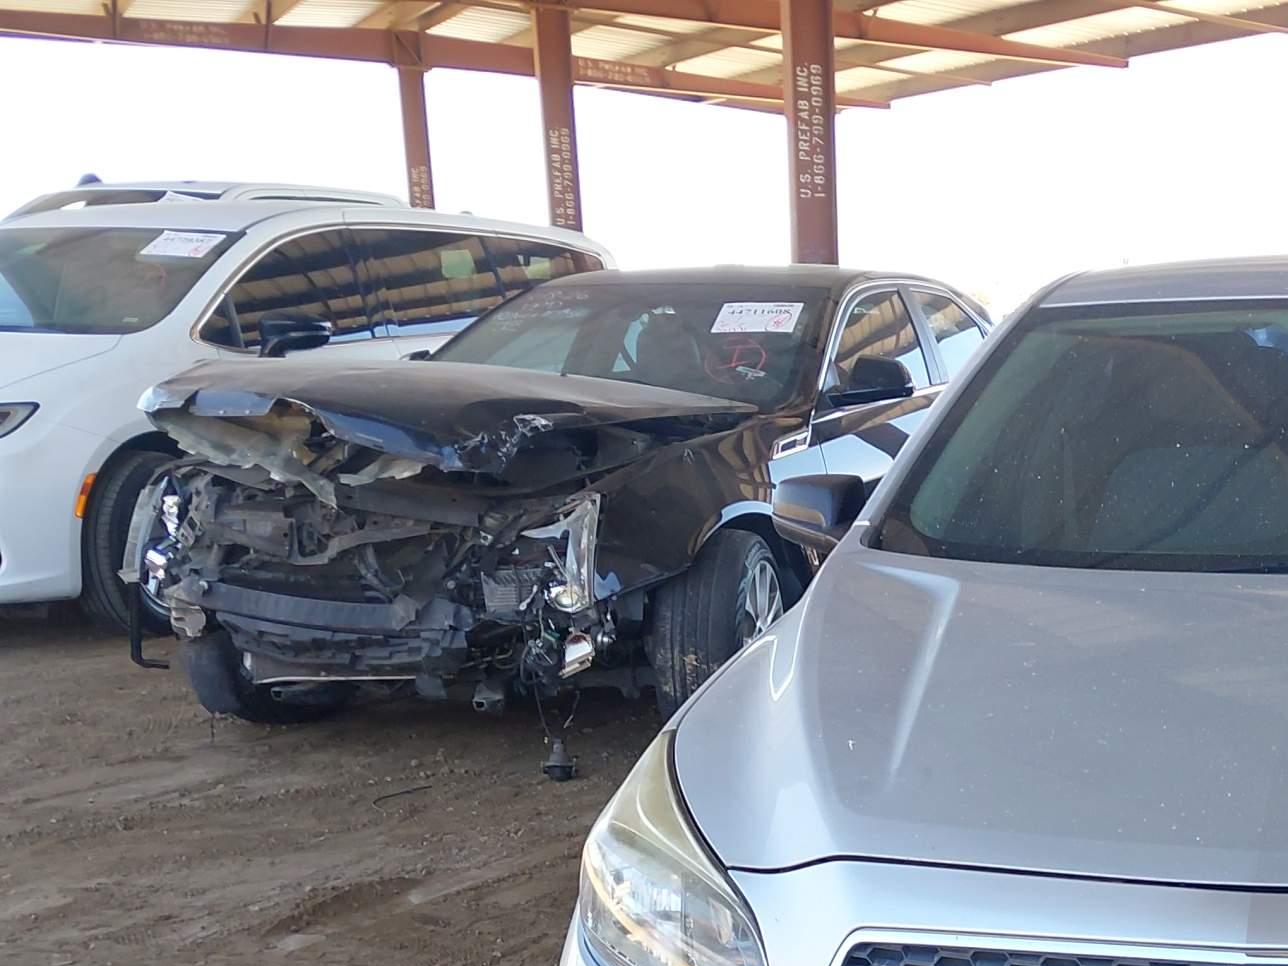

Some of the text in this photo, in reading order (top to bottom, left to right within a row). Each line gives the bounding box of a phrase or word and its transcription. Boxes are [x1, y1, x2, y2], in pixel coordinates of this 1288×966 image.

[795, 62, 813, 198] U.S. PREFAB INC.
[810, 64, 826, 197] 1-866-799-0969
